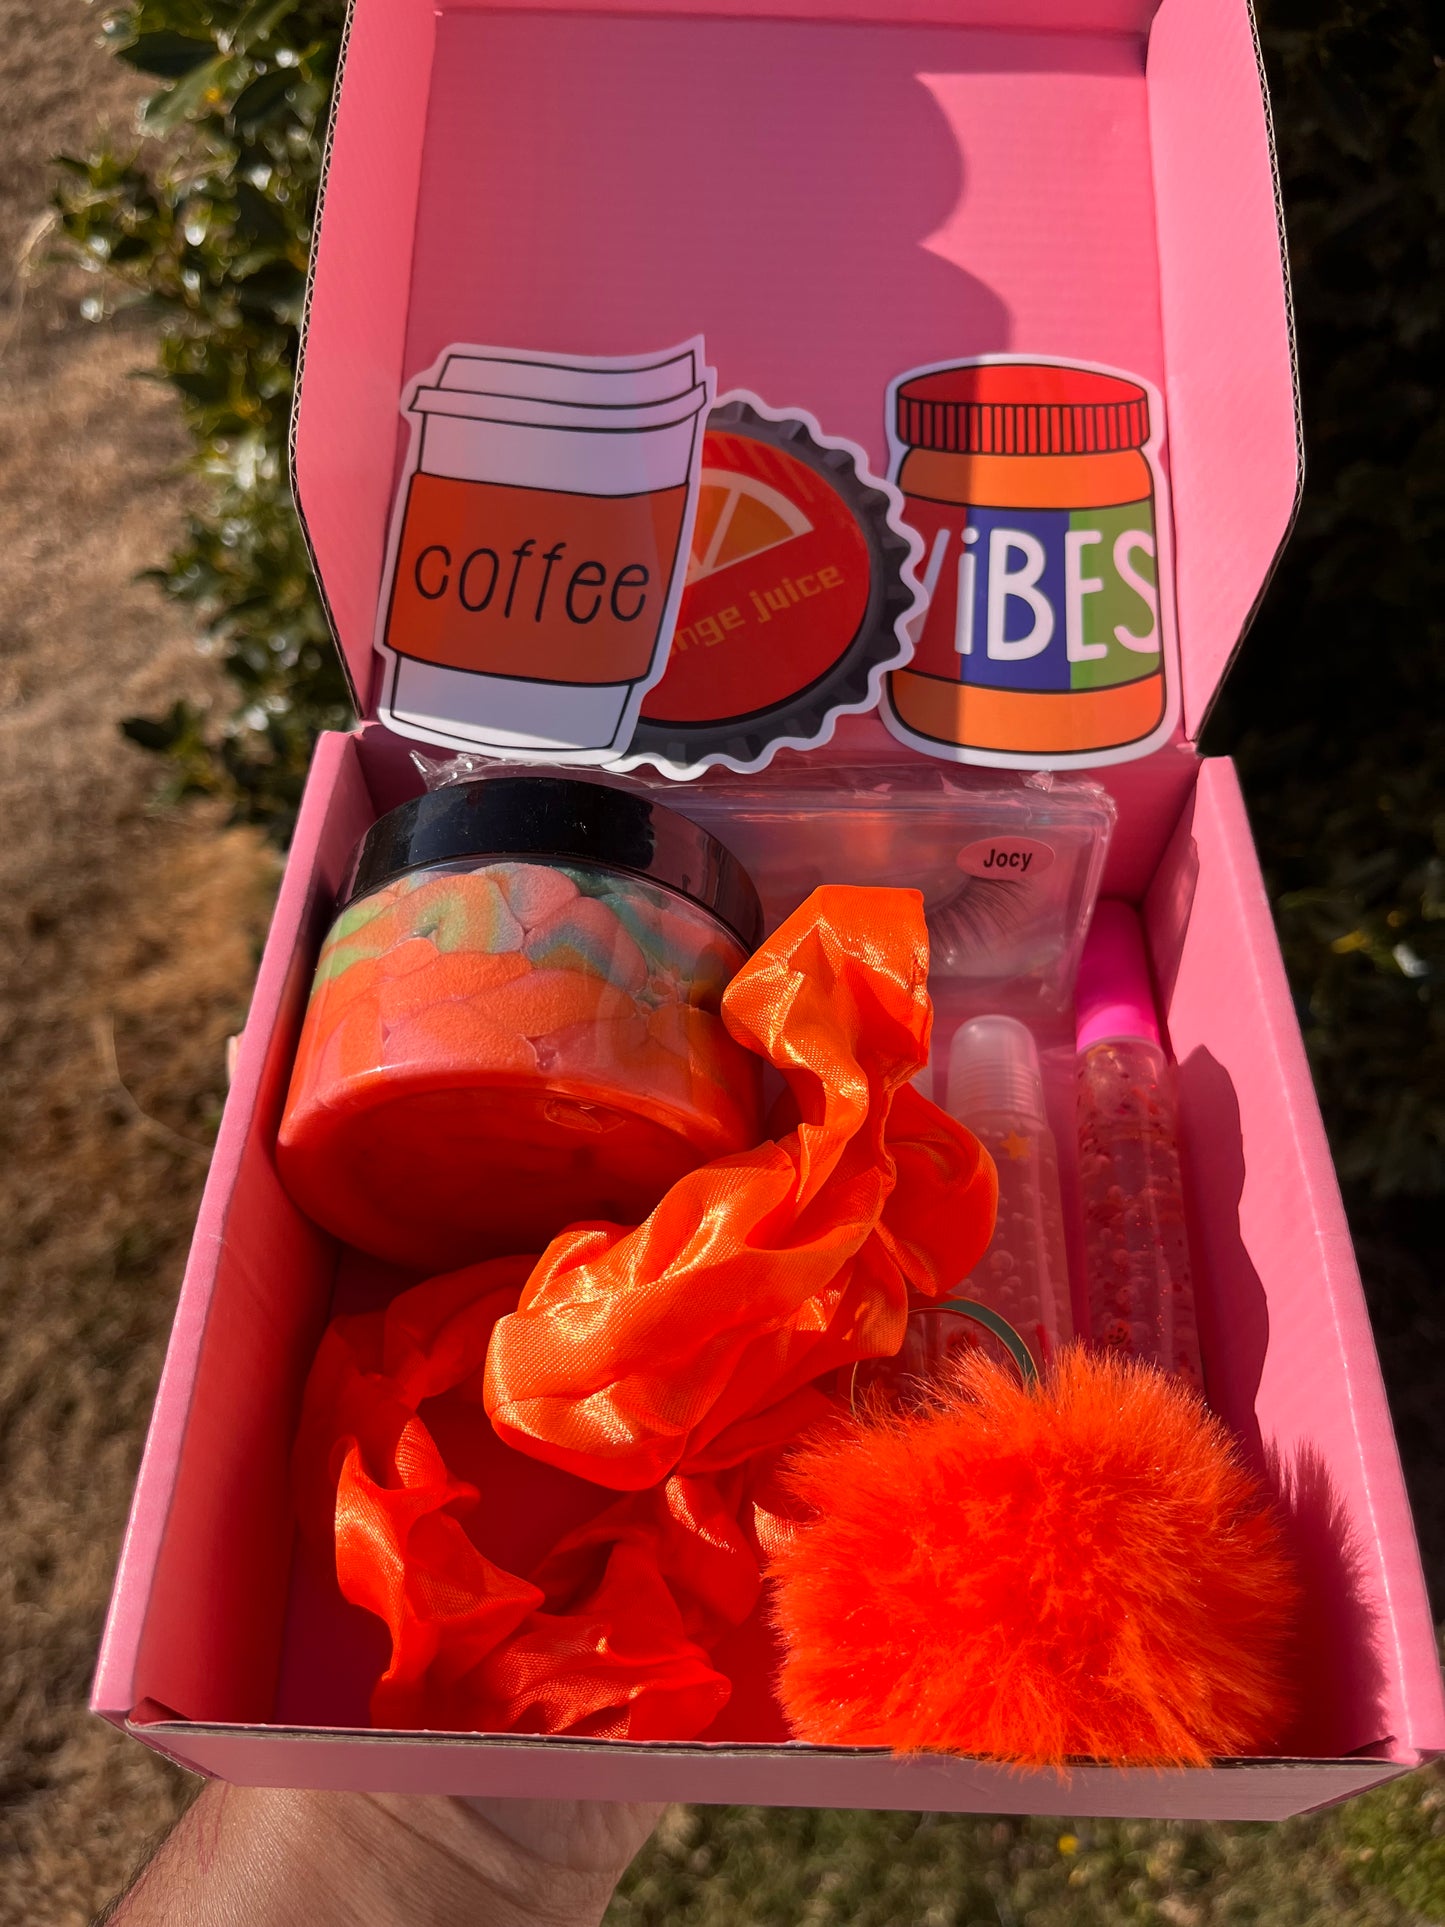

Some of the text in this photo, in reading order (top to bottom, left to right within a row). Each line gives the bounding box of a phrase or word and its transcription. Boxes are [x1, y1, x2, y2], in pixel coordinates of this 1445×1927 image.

[415, 539, 649, 624] coffee
[669, 565, 844, 657] nge juice
[983, 848, 1033, 872] Jocy
